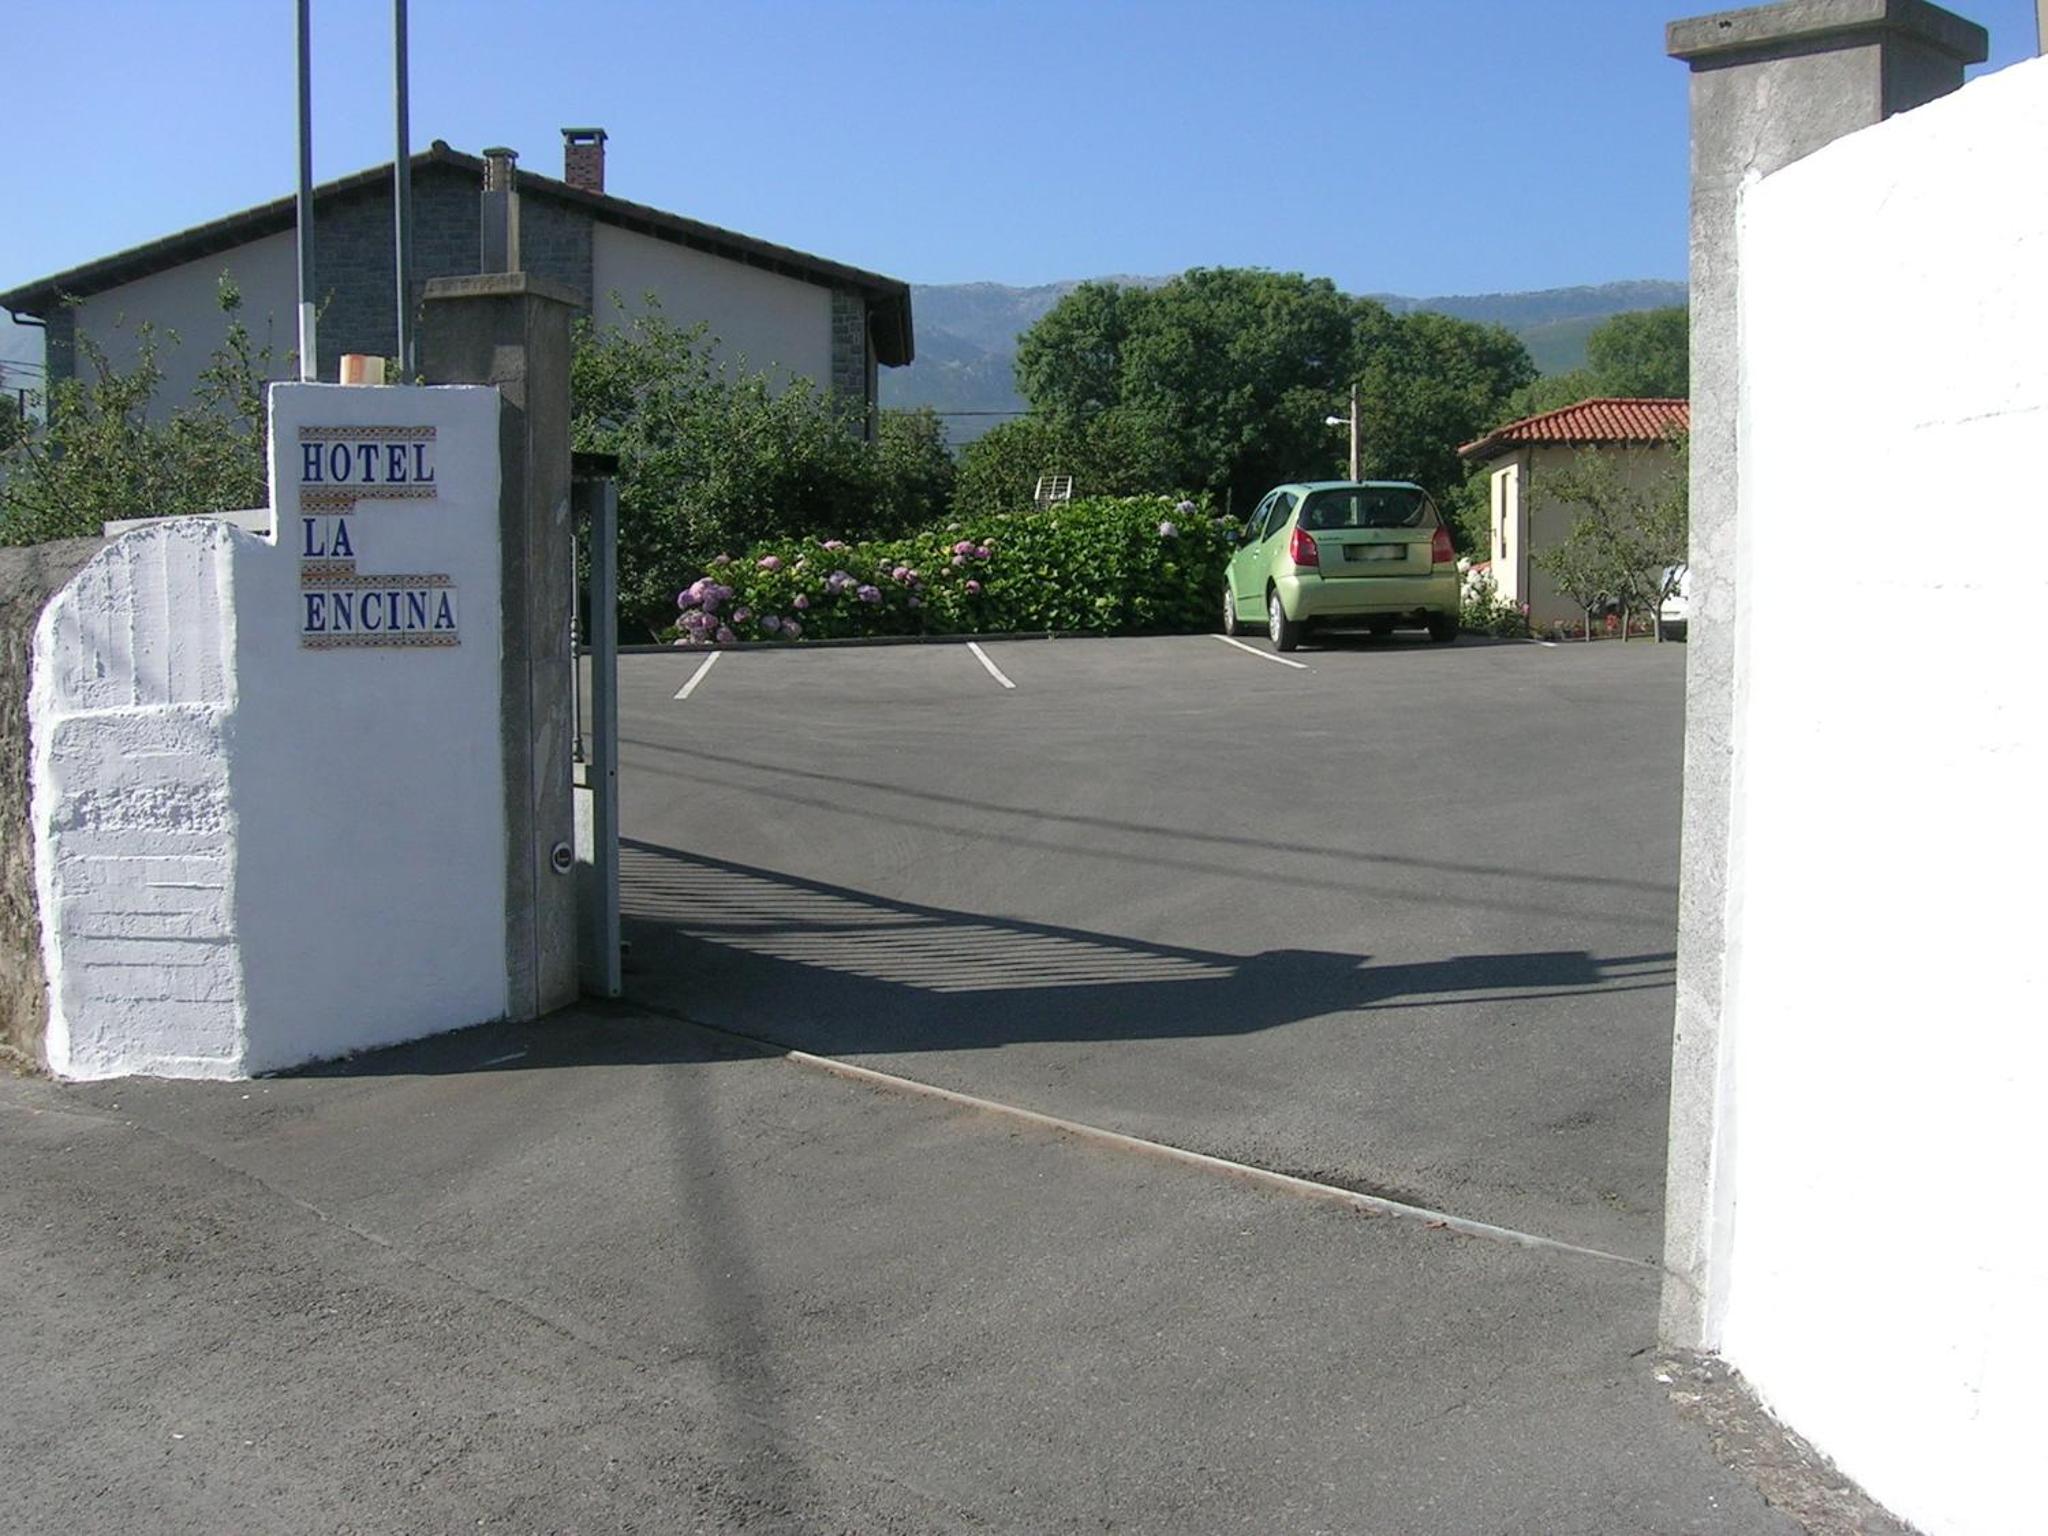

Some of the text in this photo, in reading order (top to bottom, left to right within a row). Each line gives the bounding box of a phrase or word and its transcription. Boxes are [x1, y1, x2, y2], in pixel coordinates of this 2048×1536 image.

[301, 443, 434, 482] HOTEL
[302, 518, 354, 557] LA
[304, 591, 455, 631] ENCINA
